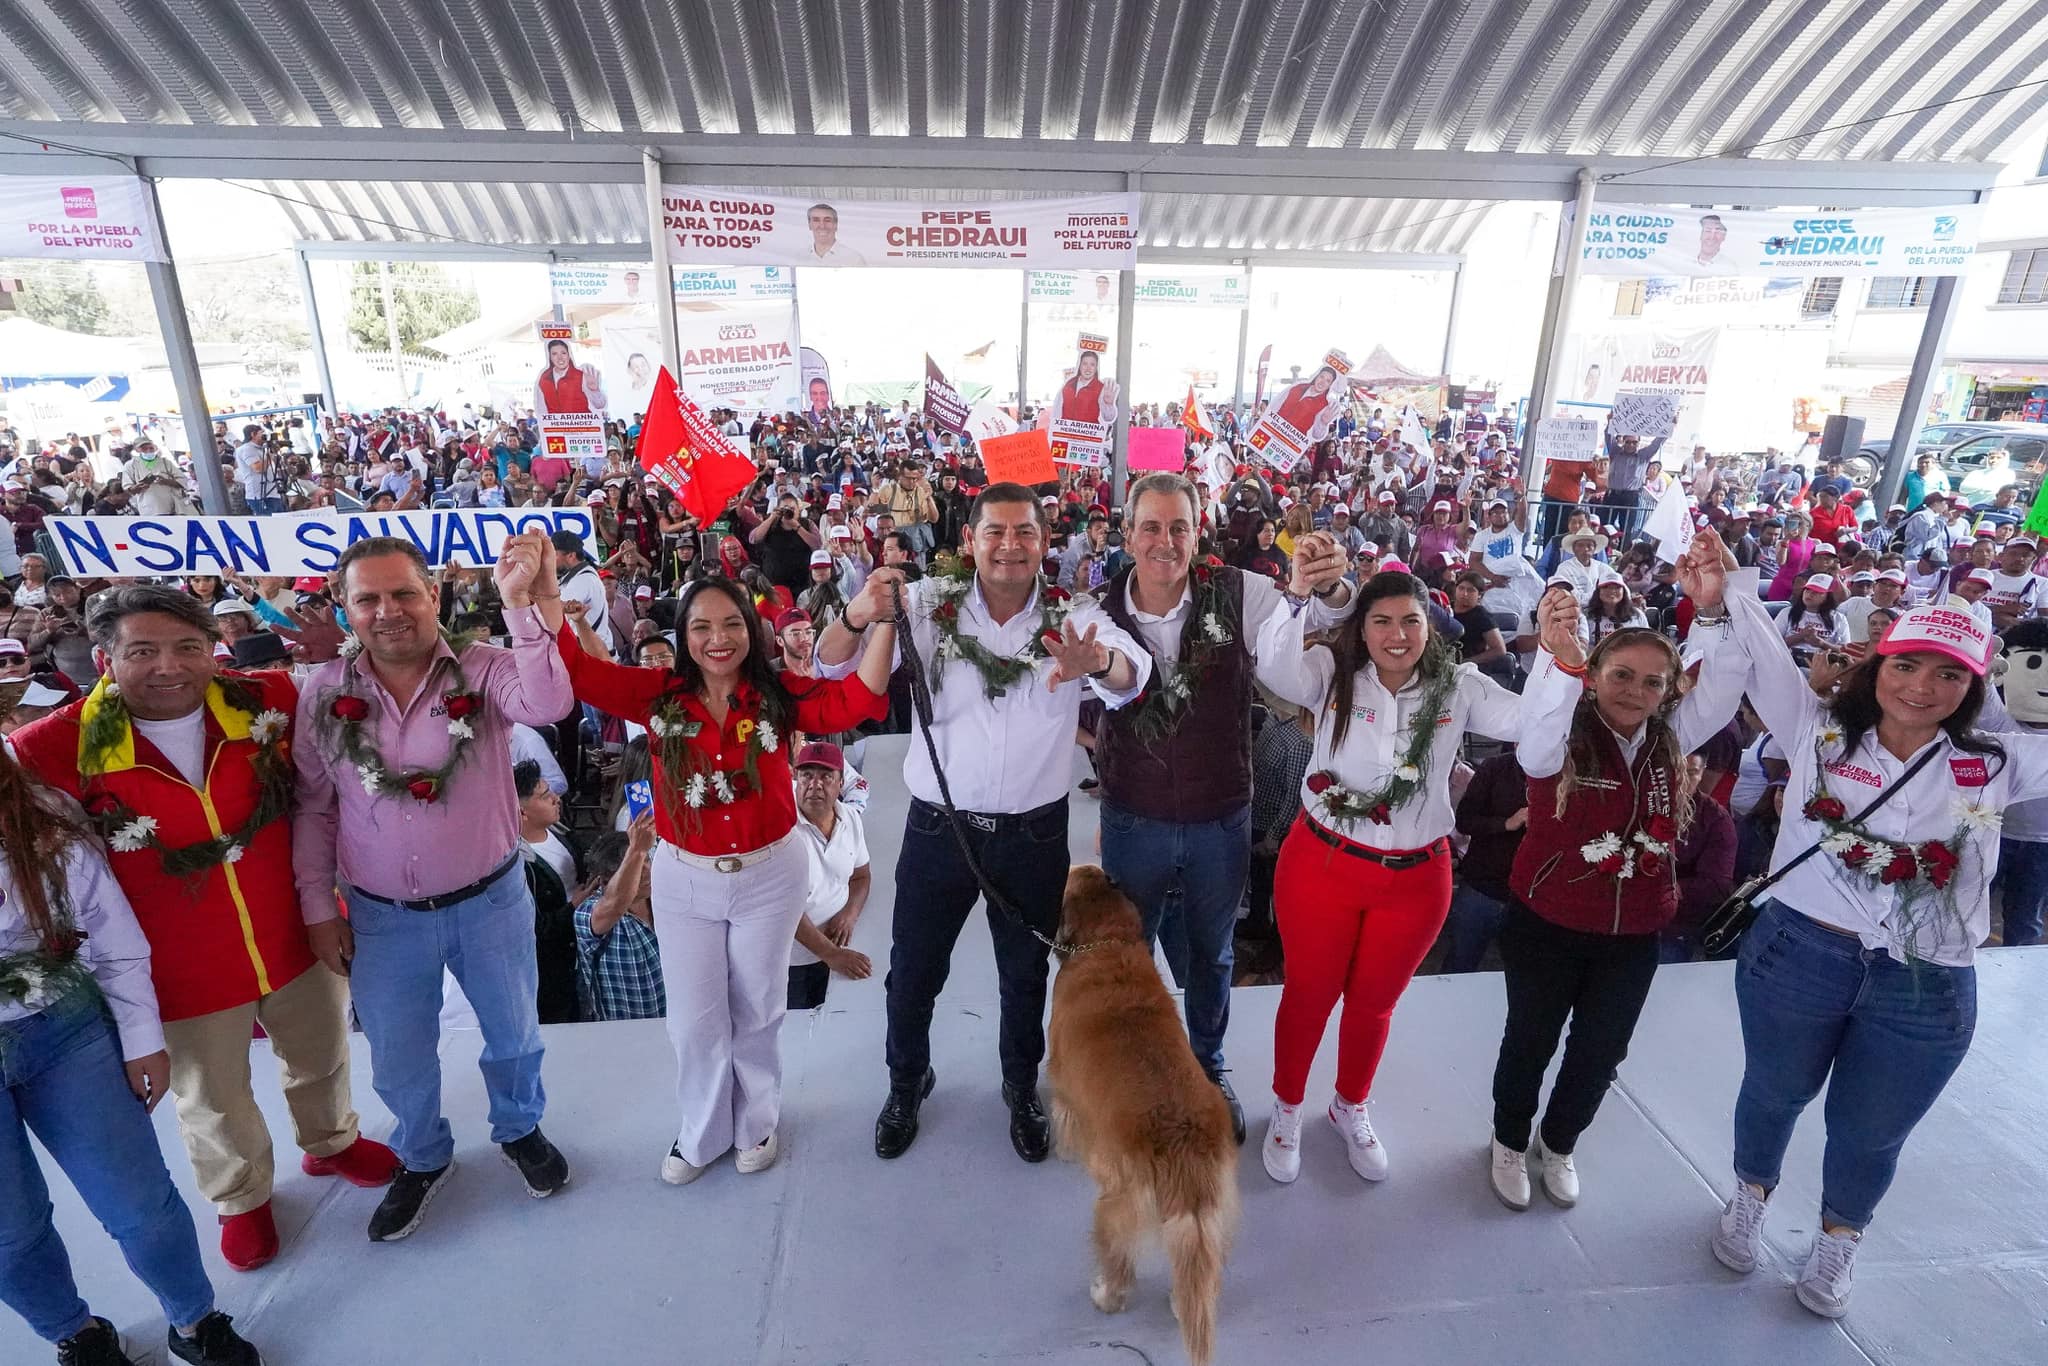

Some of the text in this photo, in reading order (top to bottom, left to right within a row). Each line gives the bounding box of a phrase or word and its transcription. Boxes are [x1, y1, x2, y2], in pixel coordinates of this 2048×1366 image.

[710, 200, 774, 215] CIUDAD
[664, 216, 773, 231] PARA TODAS
[922, 211, 992, 225] PEPE
[1068, 215, 1118, 226] morena
[1616, 215, 1674, 228] CIUDAD
[28, 224, 142, 236] POR LA PUEBLA
[1793, 219, 1856, 234] PEPE
[676, 234, 687, 247] Y
[886, 226, 1027, 247] CHEDRAUI
[1054, 231, 1139, 239] POR LA PUEBLA
[1618, 232, 1668, 244] TODAS
[43, 237, 133, 248] DEL FUTURO
[1063, 241, 1132, 250] DEL FUTURO
[1765, 236, 1885, 255] CHEDRAUI
[906, 251, 959, 259] PRESIDENTE
[674, 279, 736, 290] HEDRAUI
[719, 329, 756, 340] VOTA
[683, 341, 792, 366] ARMENTA
[1080, 341, 1107, 352] VOTA
[708, 364, 774, 375] GOBERNADOR
[1621, 365, 1707, 385] ARMENTA
[931, 402, 962, 424] morena
[673, 386, 741, 459] XEL ARIANNA
[1070, 422, 1105, 432] ARIANNA
[1281, 420, 1309, 445] ARIANNA
[549, 443, 565, 453] PT
[1052, 446, 1099, 457] PT morena
[1250, 434, 1266, 447] PT
[1270, 442, 1294, 463] morena
[54, 520, 271, 573] N-SAN
[1932, 609, 1972, 625] PEPE
[1909, 615, 1985, 642] CHEDRAUI
[1839, 763, 1882, 780] PUEBLA
[1656, 767, 1670, 817] more
